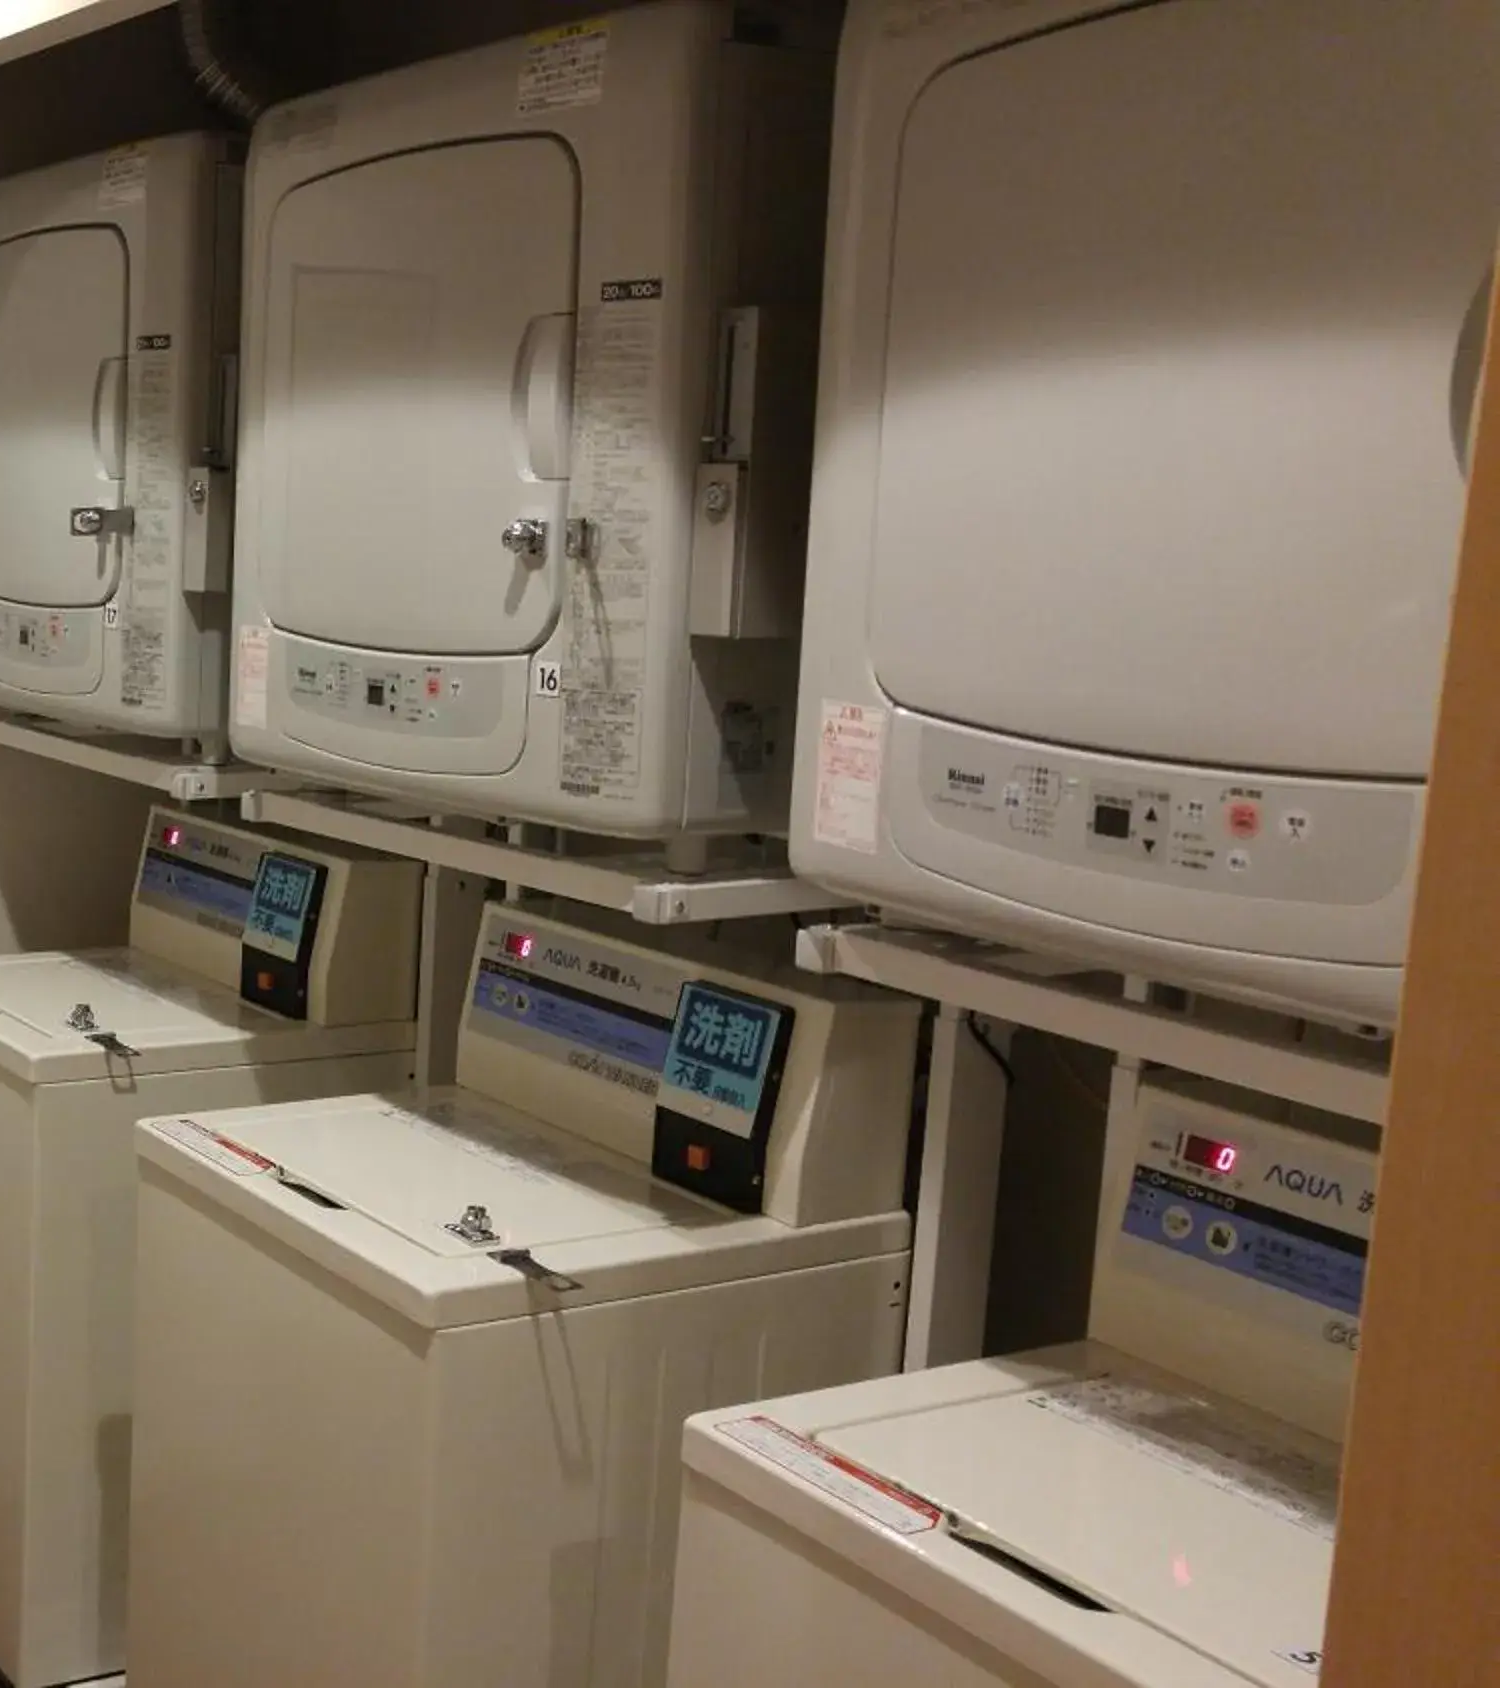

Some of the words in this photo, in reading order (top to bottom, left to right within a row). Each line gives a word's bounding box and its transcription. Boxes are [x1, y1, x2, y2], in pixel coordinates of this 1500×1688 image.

[107, 607, 117, 624] 17
[539, 668, 558, 691] 16
[260, 867, 308, 911] 洗剤
[251, 907, 275, 933] 不要
[543, 948, 582, 973] AQUA
[684, 1001, 763, 1066] 洗剤
[673, 1059, 714, 1094] 不要
[1216, 1147, 1237, 1171] 0
[1264, 1164, 1345, 1206] AQUA
